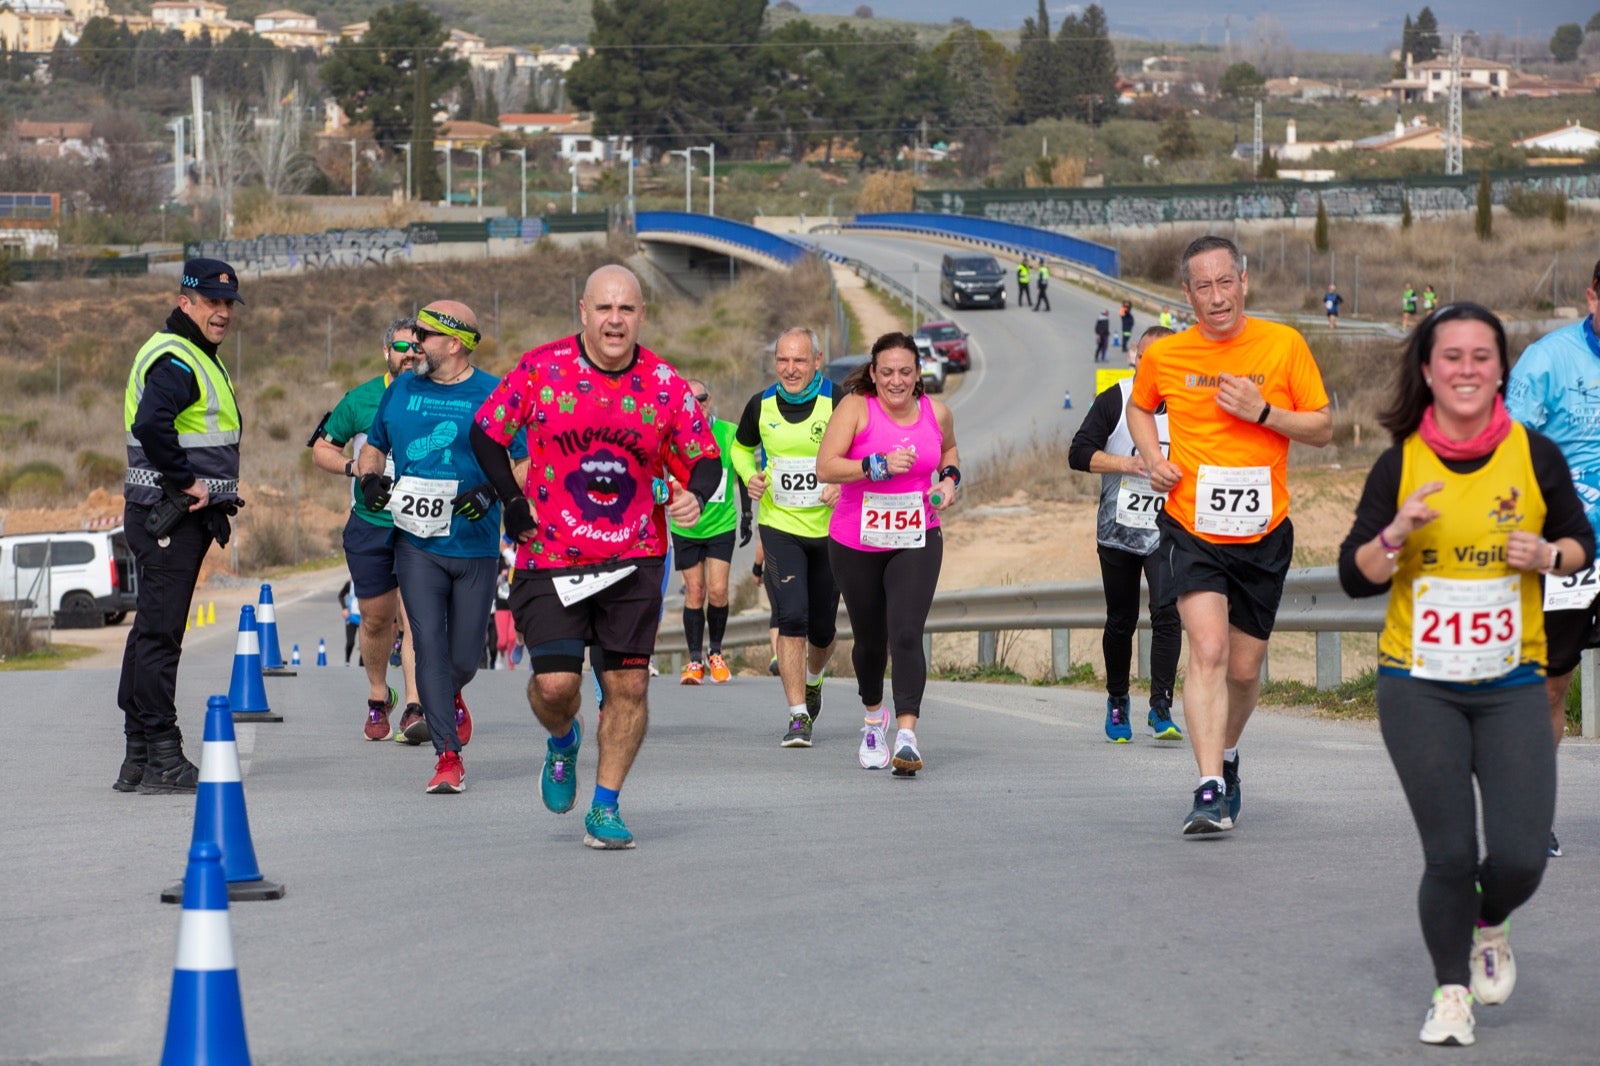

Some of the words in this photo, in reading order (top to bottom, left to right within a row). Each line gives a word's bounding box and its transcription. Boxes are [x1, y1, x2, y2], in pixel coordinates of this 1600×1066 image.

[407, 395, 423, 411] XI
[553, 426, 649, 467] Monstruo
[781, 473, 818, 491] 629
[401, 495, 444, 518] 268
[1127, 493, 1166, 513] 270
[1210, 488, 1260, 513] 573
[561, 509, 577, 527] en
[866, 509, 922, 530] 2154
[1421, 608, 1513, 645] 2153
